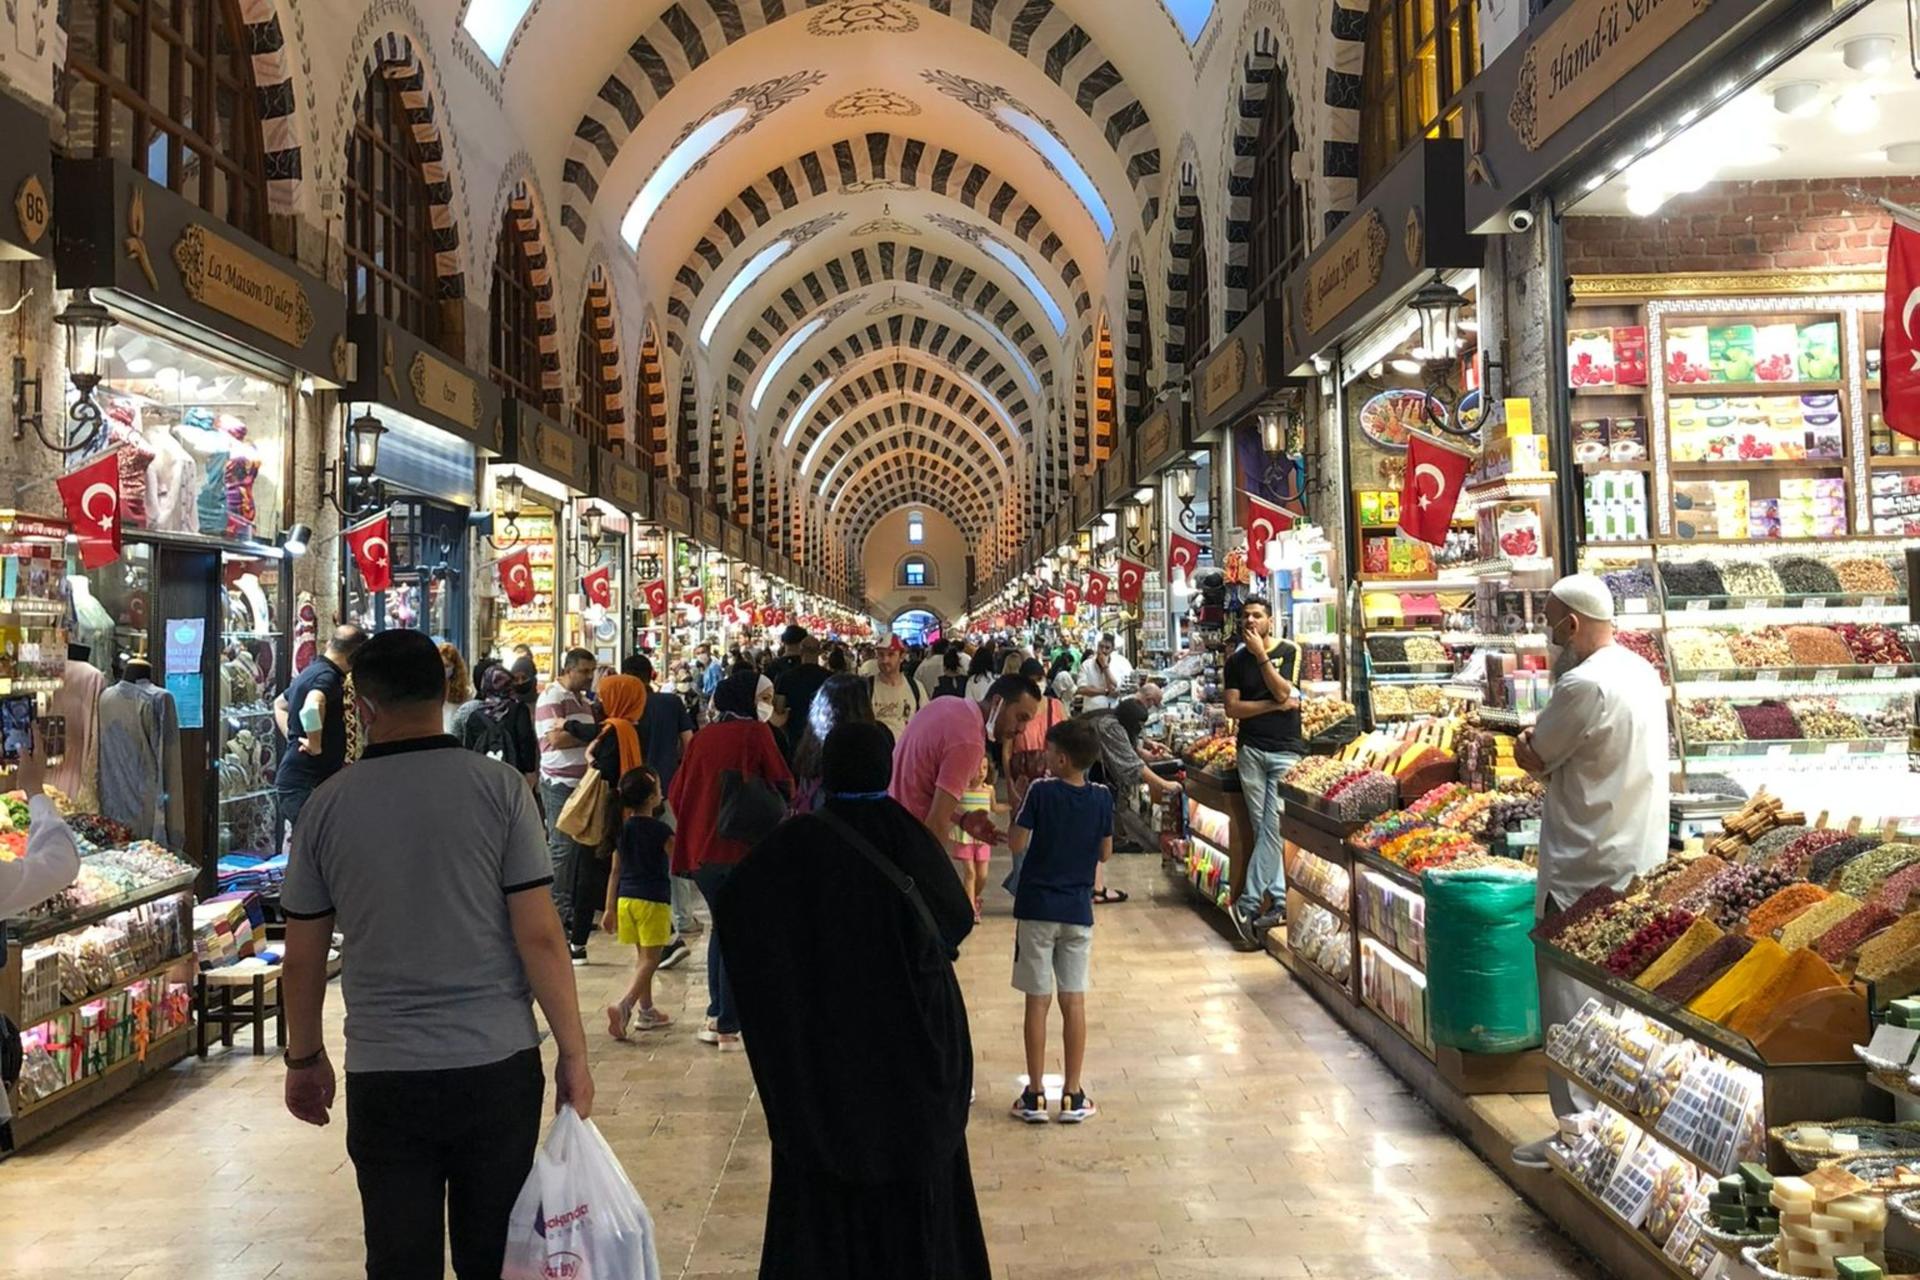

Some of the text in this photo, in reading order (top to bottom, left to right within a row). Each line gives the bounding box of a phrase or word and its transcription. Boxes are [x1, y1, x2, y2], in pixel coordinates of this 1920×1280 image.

[1549, 3, 1620, 99] Hamd-ü
[27, 192, 43, 224] 86
[207, 254, 222, 282] La
